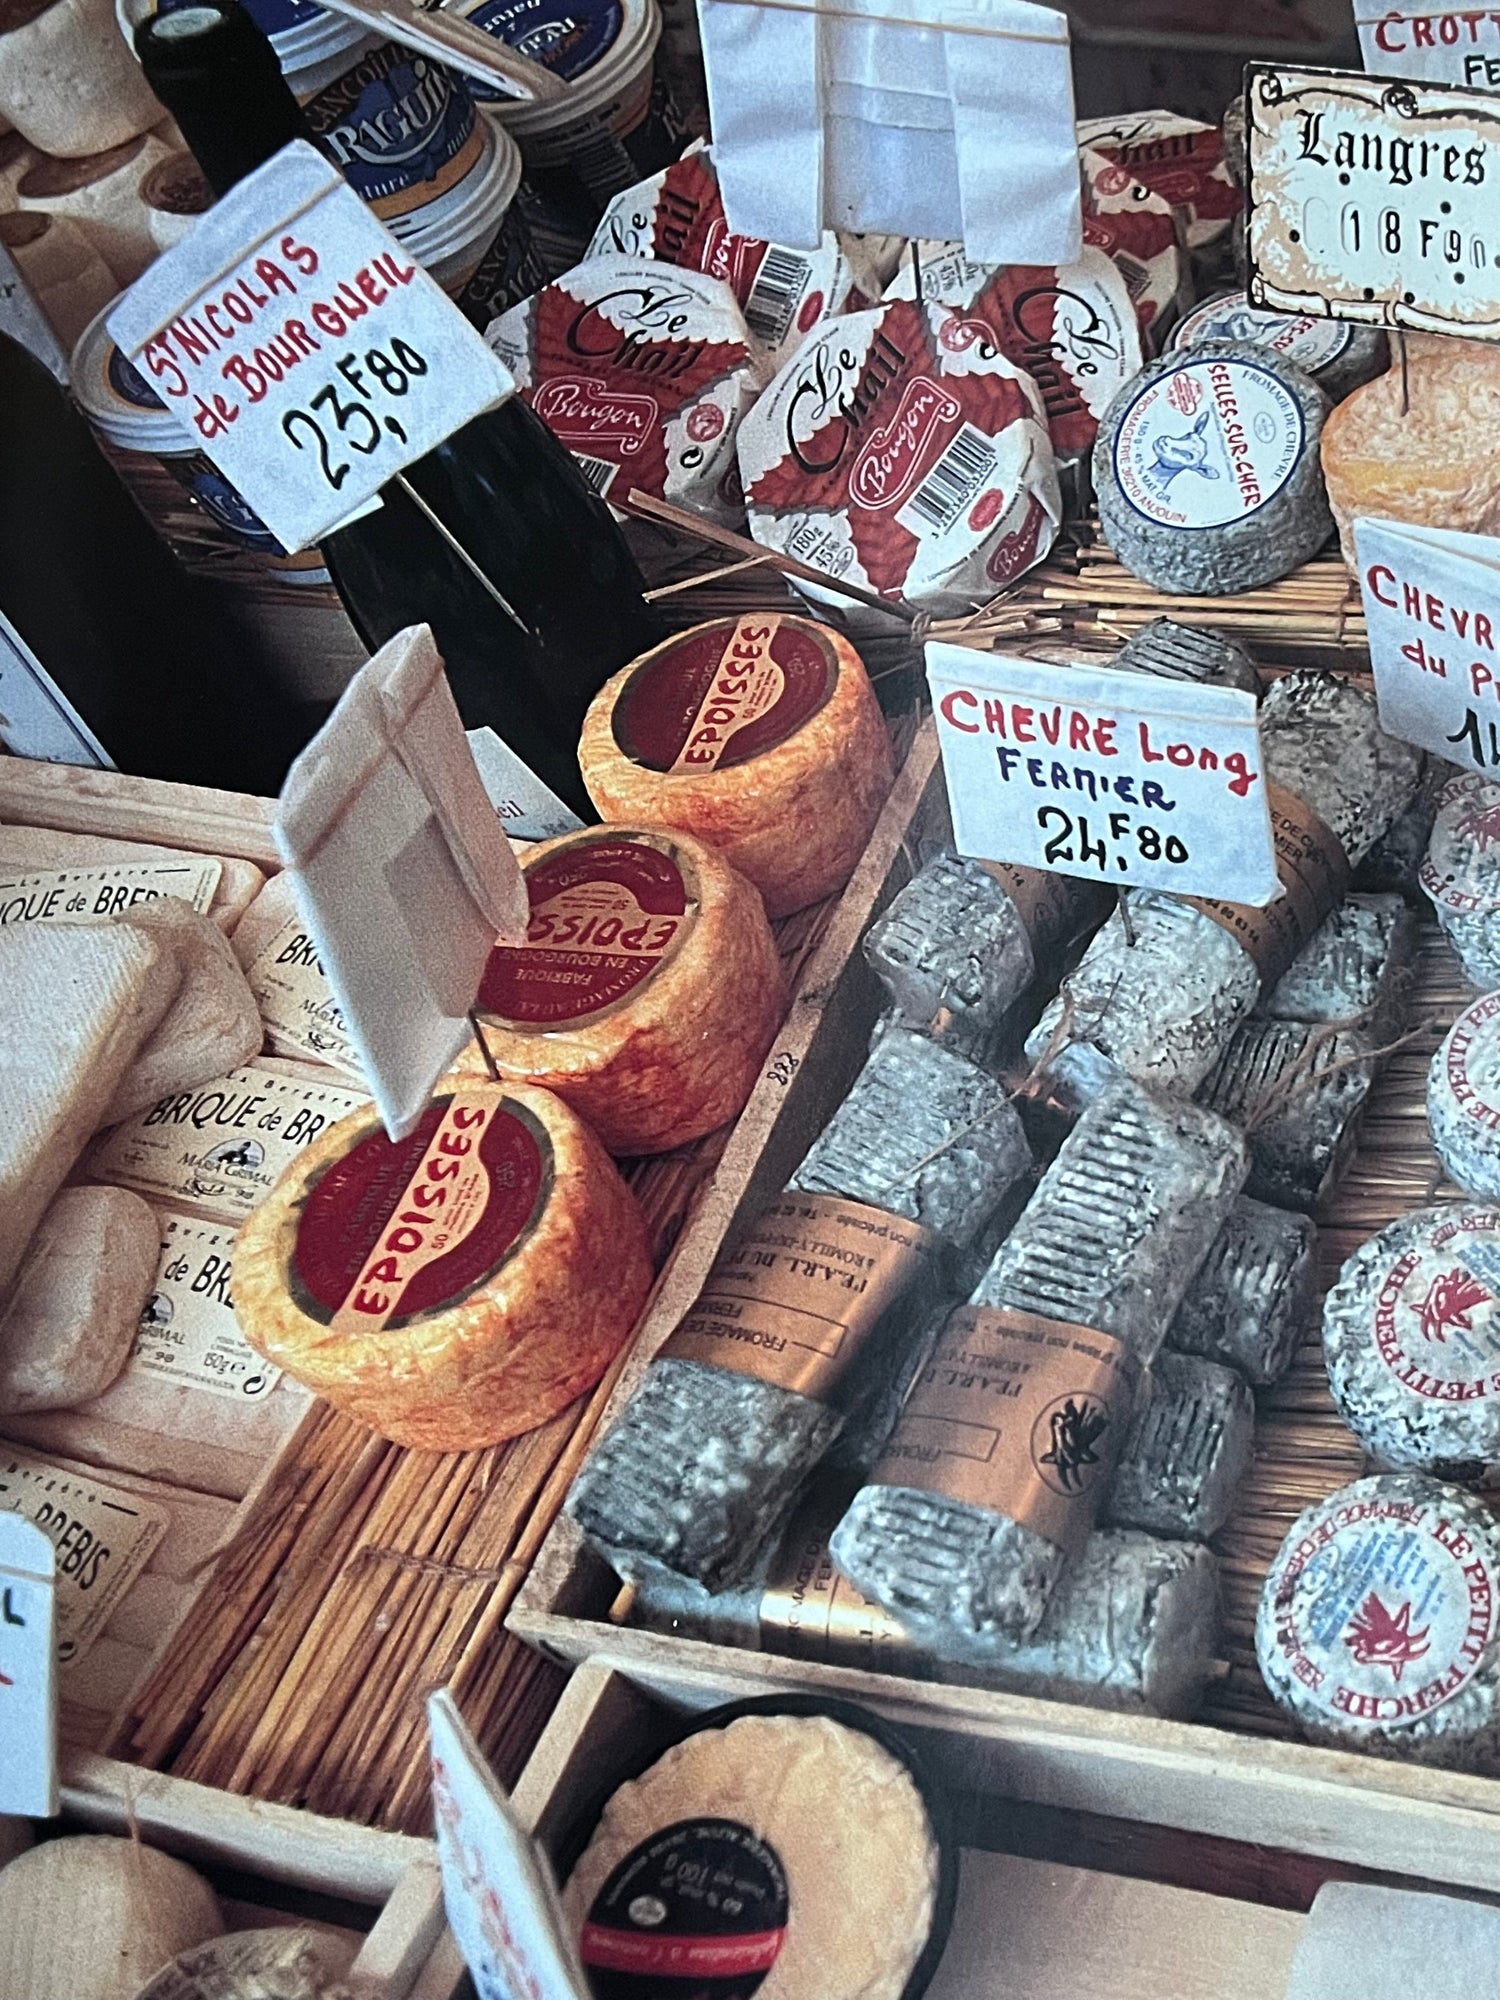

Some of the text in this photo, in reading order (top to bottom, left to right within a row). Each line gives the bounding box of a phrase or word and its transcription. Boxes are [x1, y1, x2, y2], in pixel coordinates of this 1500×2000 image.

[1295, 109, 1486, 186] Langres
[172, 236, 319, 368] NICOLAS
[619, 286, 692, 333] Le
[1063, 317, 1119, 378] Le
[194, 385, 241, 439] de
[543, 384, 643, 430] Bougon
[796, 344, 857, 420] Le
[1242, 370, 1291, 411] FROMAGE
[1284, 412, 1297, 429] DE
[859, 394, 934, 498] Bougon
[1120, 390, 1159, 464] FROMAGERIE
[1207, 364, 1261, 507] SELLES-SUR-CHER
[685, 626, 770, 764] EPOISSES
[1401, 638, 1446, 698] du
[940, 690, 1258, 797] CHEVRE Long
[996, 747, 1176, 811] FERMIER
[65, 893, 87, 912] de
[528, 914, 678, 950] EPOISS
[515, 968, 593, 986] FABRIQUE
[1448, 1026, 1476, 1106] PETIT
[144, 1092, 266, 1130] BRIQUE
[258, 1107, 281, 1131] de
[353, 1106, 485, 1315] EPOISSES
[165, 1254, 188, 1281] de
[1397, 1363, 1487, 1401] PETIT
[1431, 1519, 1473, 1559] LE
[1461, 1558, 1491, 1665] PETIT
[1331, 1664, 1468, 1720] PERCHE
